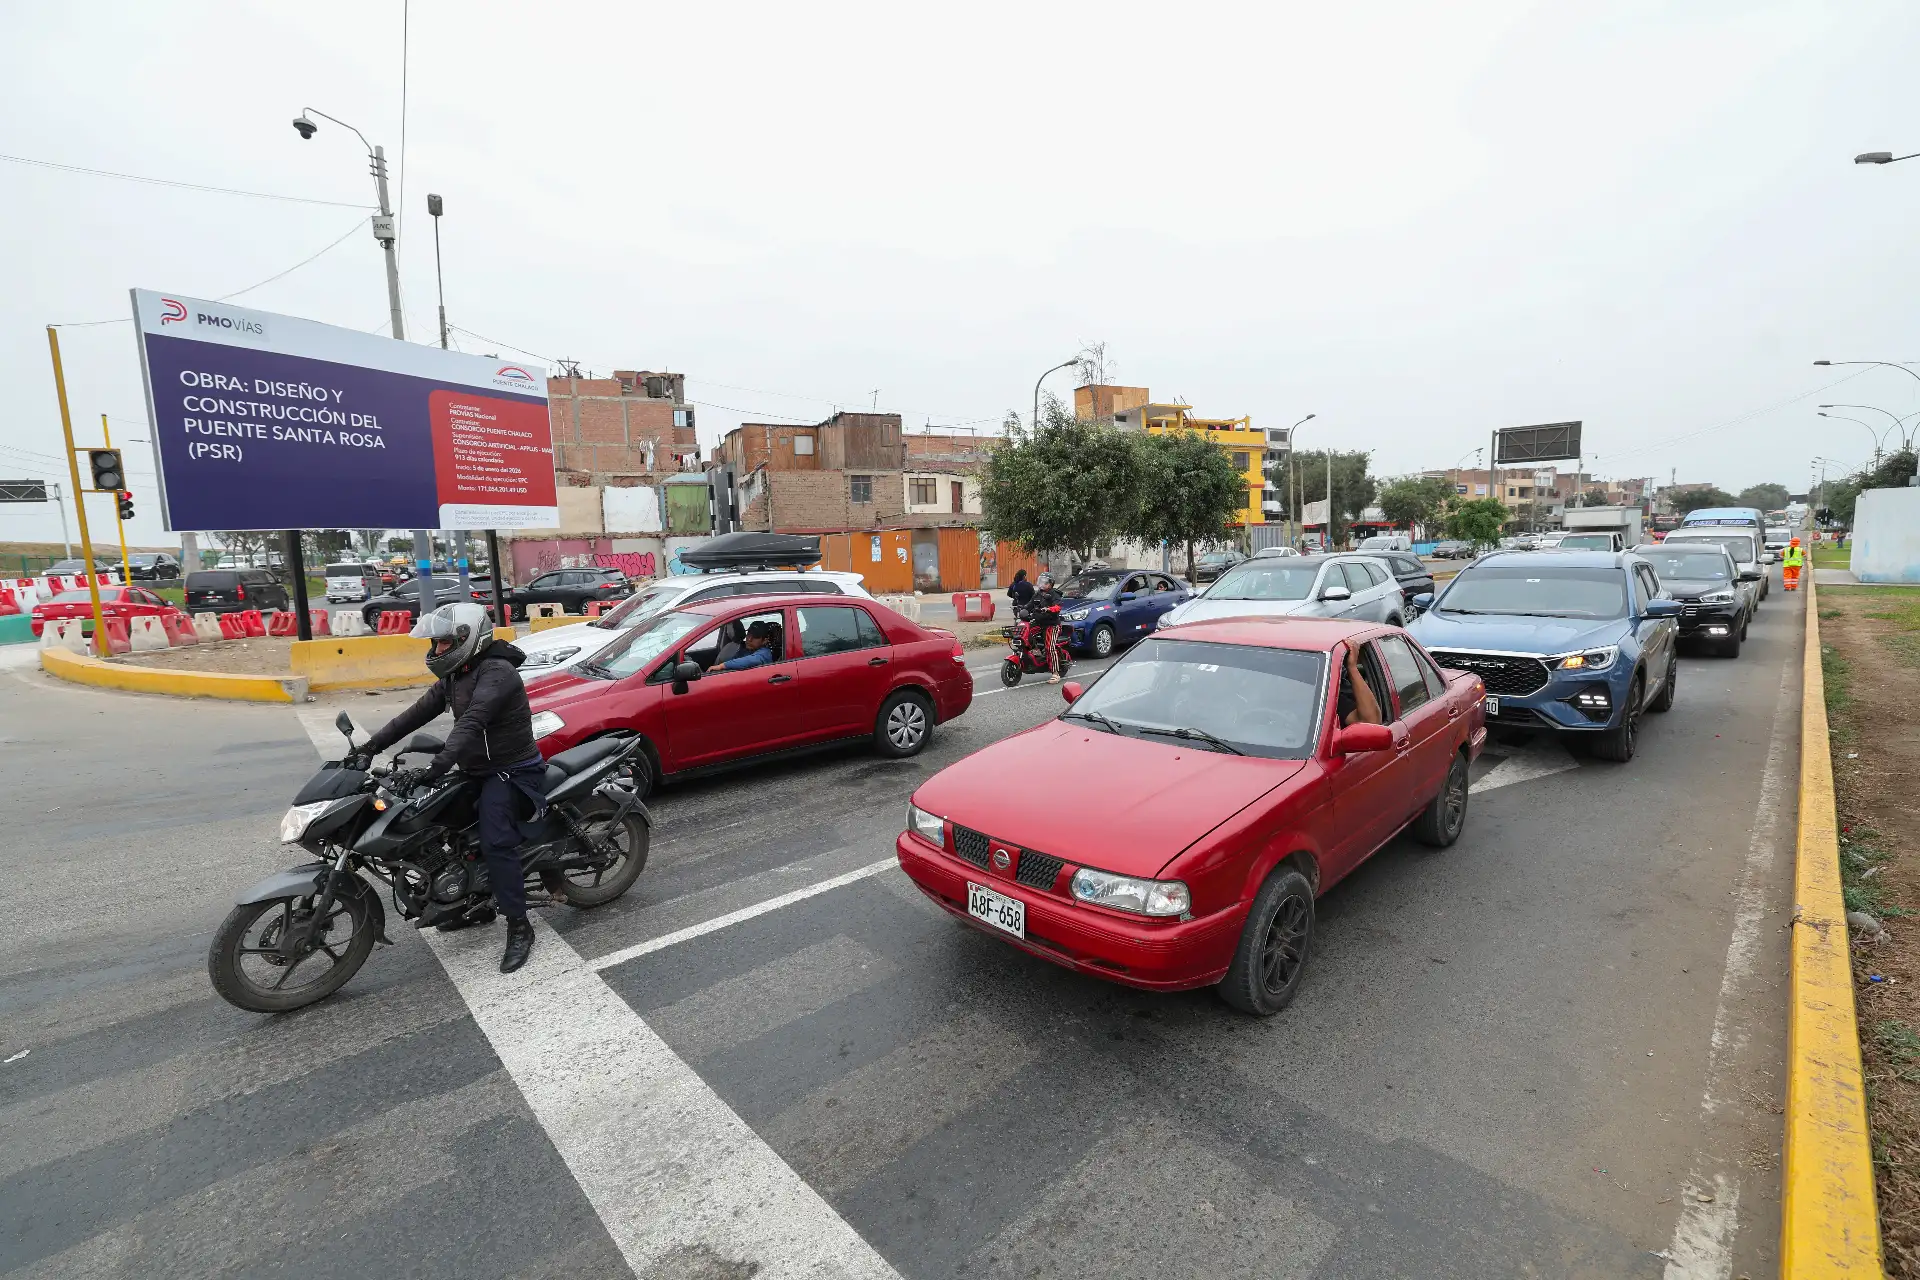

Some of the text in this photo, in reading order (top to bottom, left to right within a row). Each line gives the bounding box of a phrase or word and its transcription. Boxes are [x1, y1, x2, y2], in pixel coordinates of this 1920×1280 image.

[180, 370, 343, 403] OBRA: DISEÑO Y
[183, 395, 382, 430] CONSTRUCCIÓN DEL
[183, 417, 386, 449] PUENTE SANTA ROSA
[451, 424, 532, 438] CONSORCIO PUENTE CHALACO
[452, 438, 488, 448] CONSORCIO
[188, 441, 243, 463] (PSR)
[971, 892, 1021, 932] A8F-658
